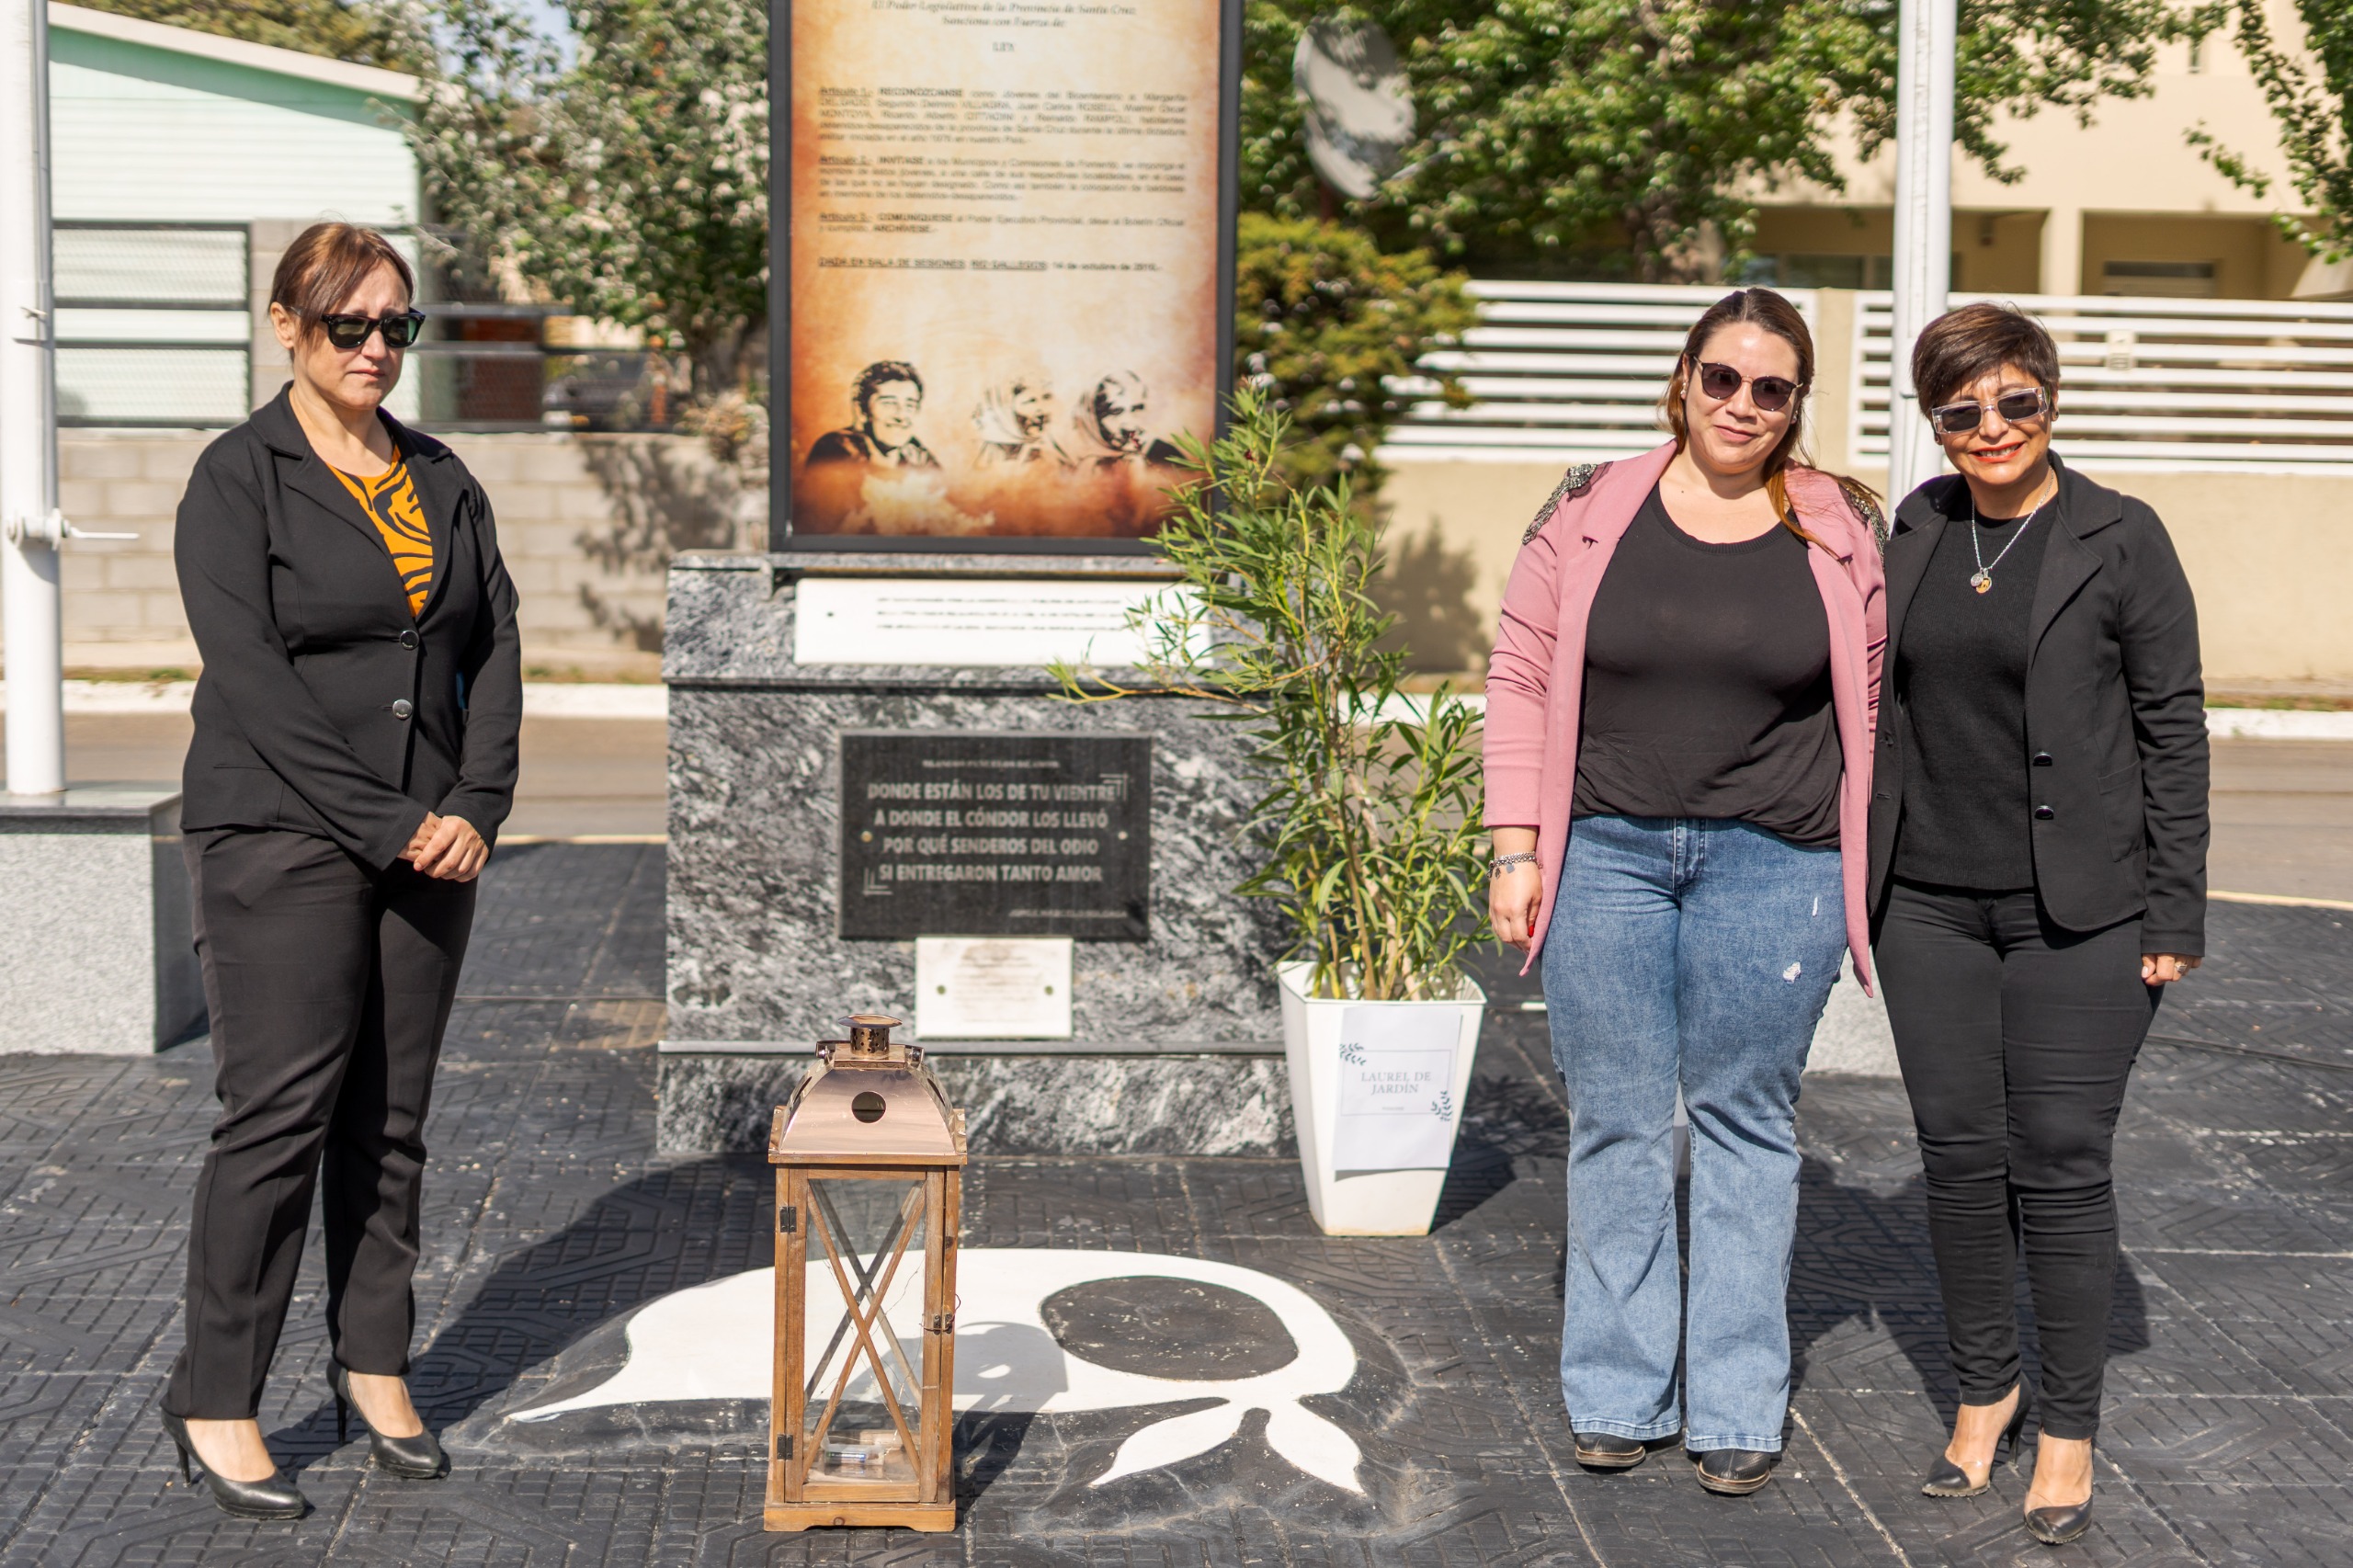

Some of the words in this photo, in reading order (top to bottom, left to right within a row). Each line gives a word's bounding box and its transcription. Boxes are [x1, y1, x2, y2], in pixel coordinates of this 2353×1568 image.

[868, 783, 921, 800] DONDE
[924, 778, 972, 800] ESTÁN
[976, 784, 1004, 800] LOS
[1006, 785, 1027, 800] DE
[1030, 785, 1050, 800] TU
[1052, 785, 1116, 801] VIENTRE
[874, 810, 885, 826] A
[889, 811, 942, 826] DONDE
[945, 812, 961, 826] EL
[965, 806, 1029, 827] CÓNDOR
[1033, 812, 1060, 827] LOS
[1063, 809, 1108, 828] LLEVÓ
[883, 837, 914, 853] POR
[916, 834, 948, 856] QUÉ
[950, 838, 1027, 854] SENDEROS
[1030, 838, 1057, 855] DEL
[1060, 838, 1098, 855] ODIO
[879, 865, 893, 881] SI
[896, 864, 997, 881] ENTREGARON
[1001, 866, 1053, 881] TANTO
[1056, 866, 1103, 881] AMOR
[1361, 1072, 1411, 1082] LAUREL
[1414, 1072, 1432, 1081] DE
[1370, 1083, 1419, 1096] JARDÍN
